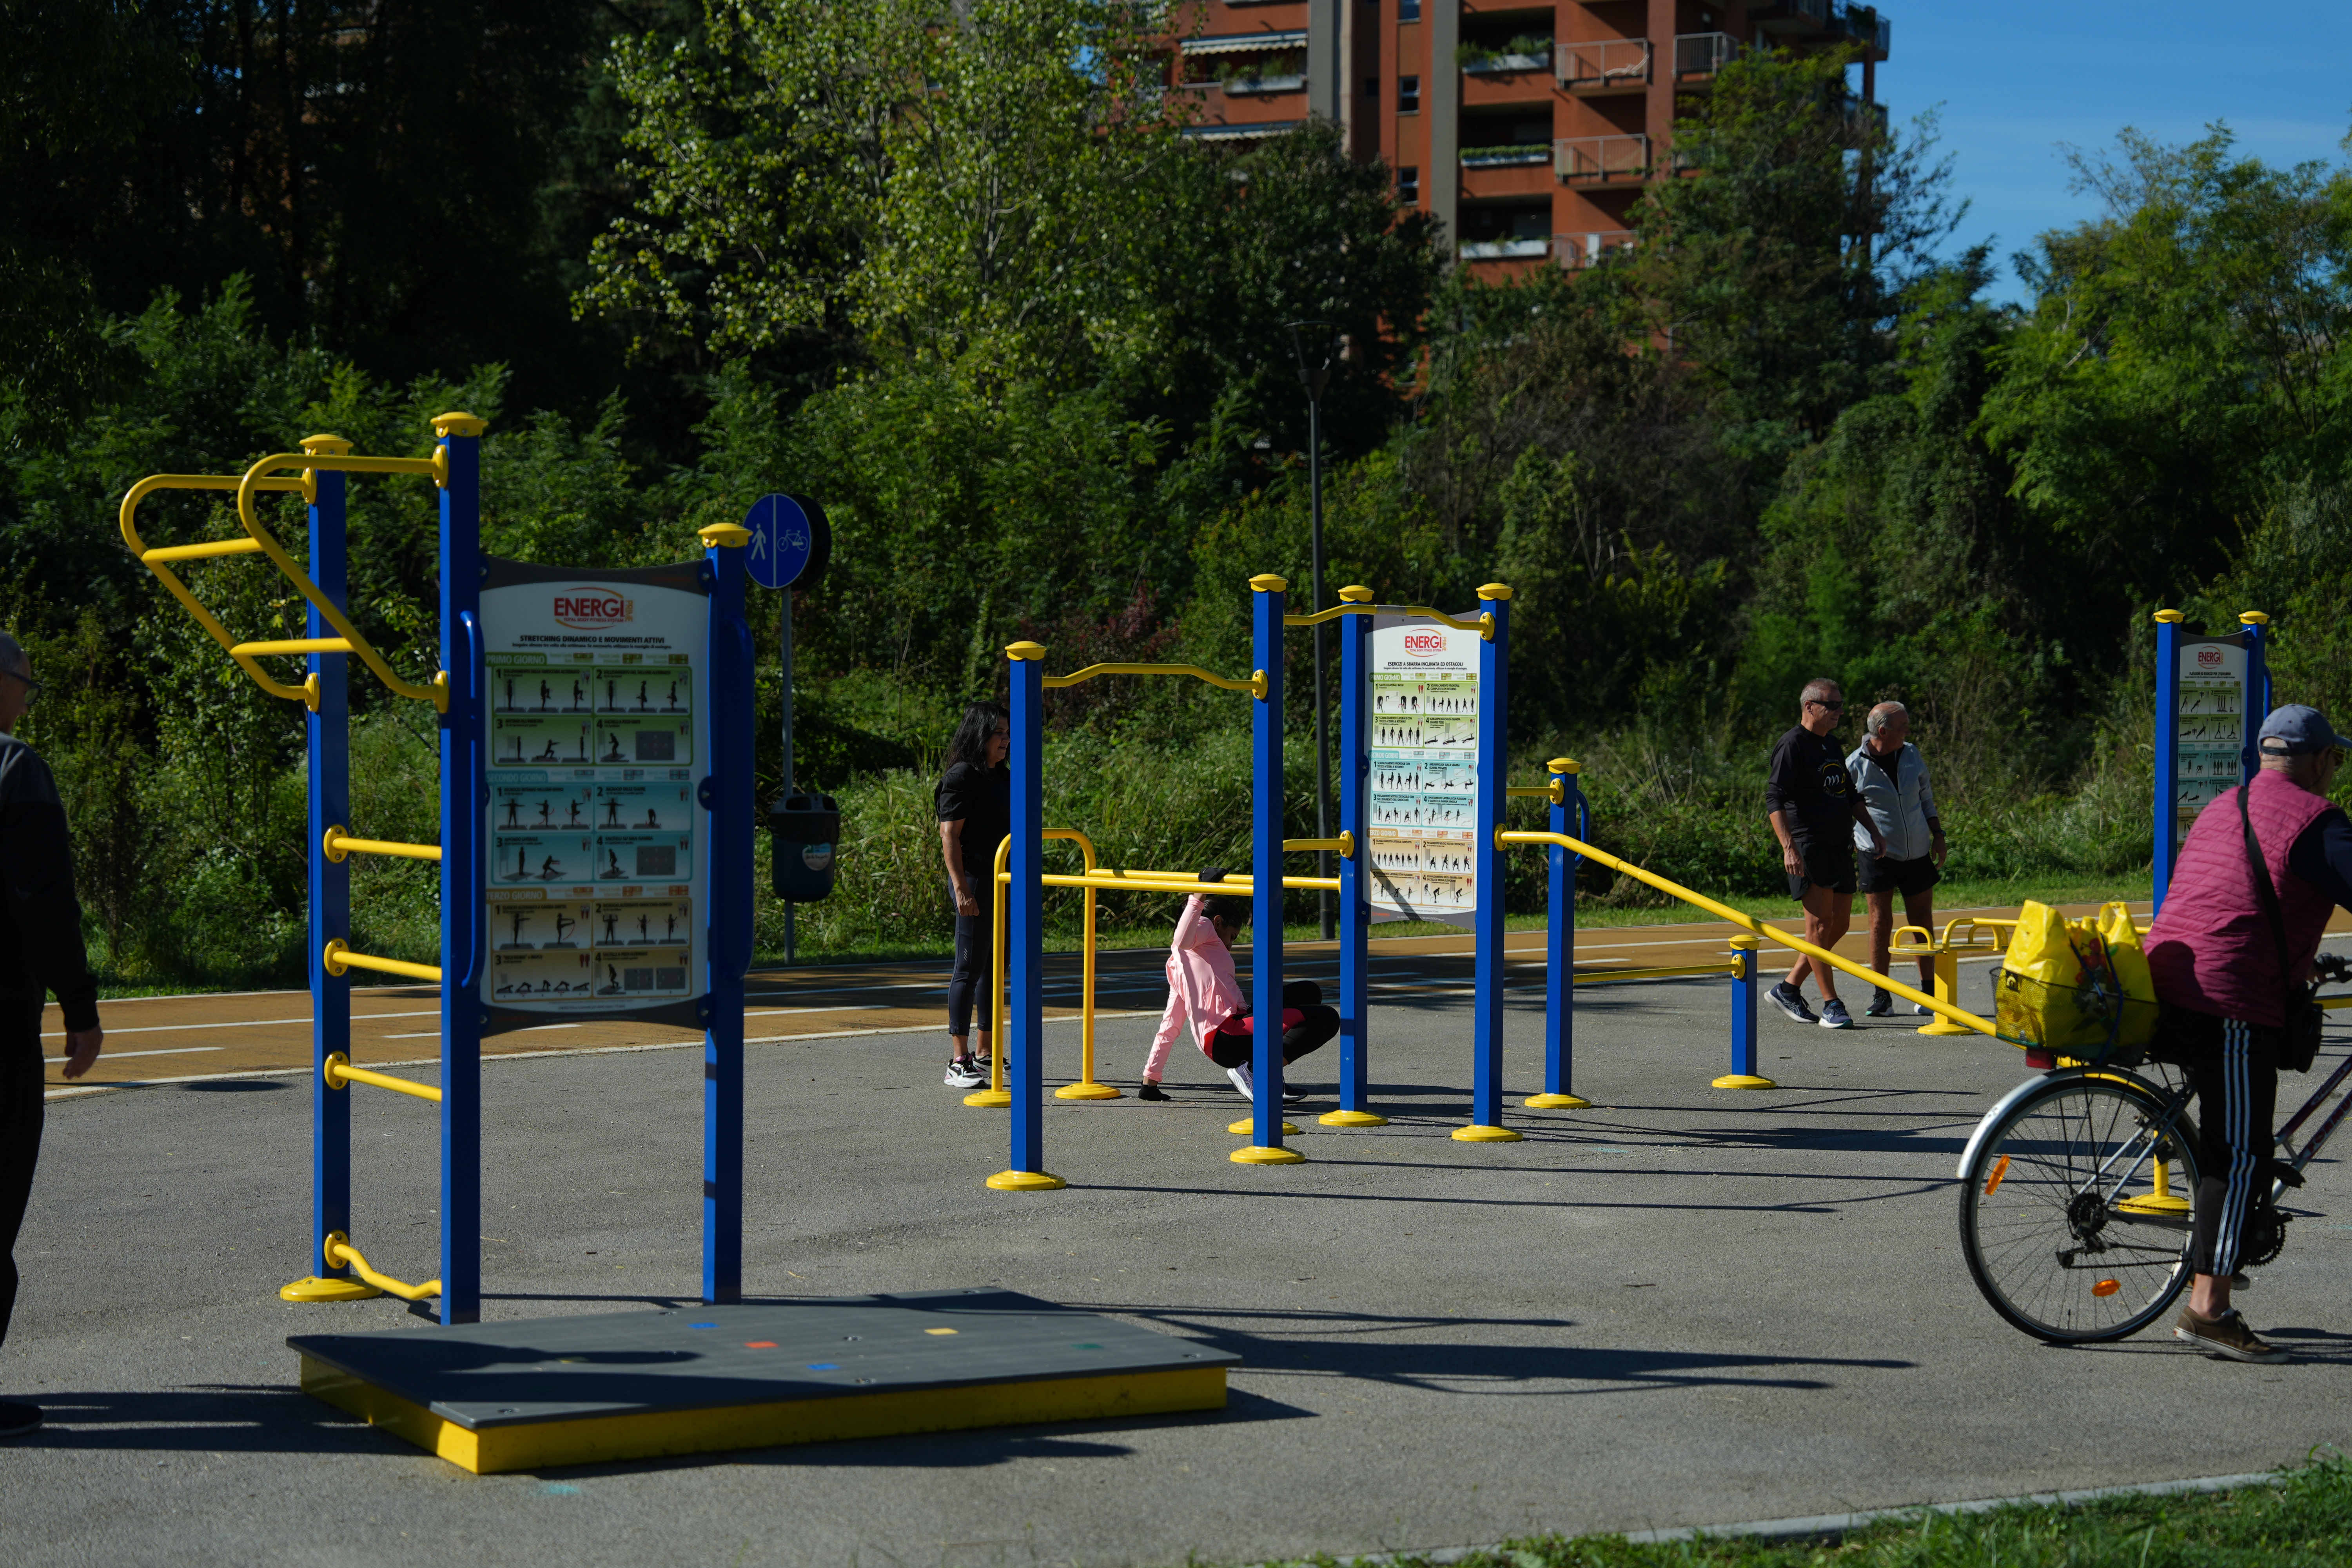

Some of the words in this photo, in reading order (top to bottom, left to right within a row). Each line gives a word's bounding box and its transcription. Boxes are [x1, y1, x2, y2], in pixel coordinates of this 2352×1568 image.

[554, 597, 624, 617] ENERGI
[625, 600, 633, 622] PRIME
[1405, 636, 1442, 648] ENERGI
[486, 655, 512, 664] PRIMO
[514, 655, 544, 664] GIORNO
[2198, 652, 2221, 662] ENERGI
[496, 669, 501, 678] 1
[596, 670, 602, 679] 2
[497, 719, 503, 729] 3
[597, 719, 603, 728] 4
[497, 787, 501, 796] 1
[597, 787, 603, 796] 2
[497, 837, 502, 847] 3
[597, 836, 603, 845] 4
[486, 892, 510, 900] TERZO
[511, 891, 543, 900] GIORNO
[495, 905, 500, 914] 1
[595, 904, 601, 913] 2
[495, 955, 501, 965] 3
[595, 953, 601, 962] 4
